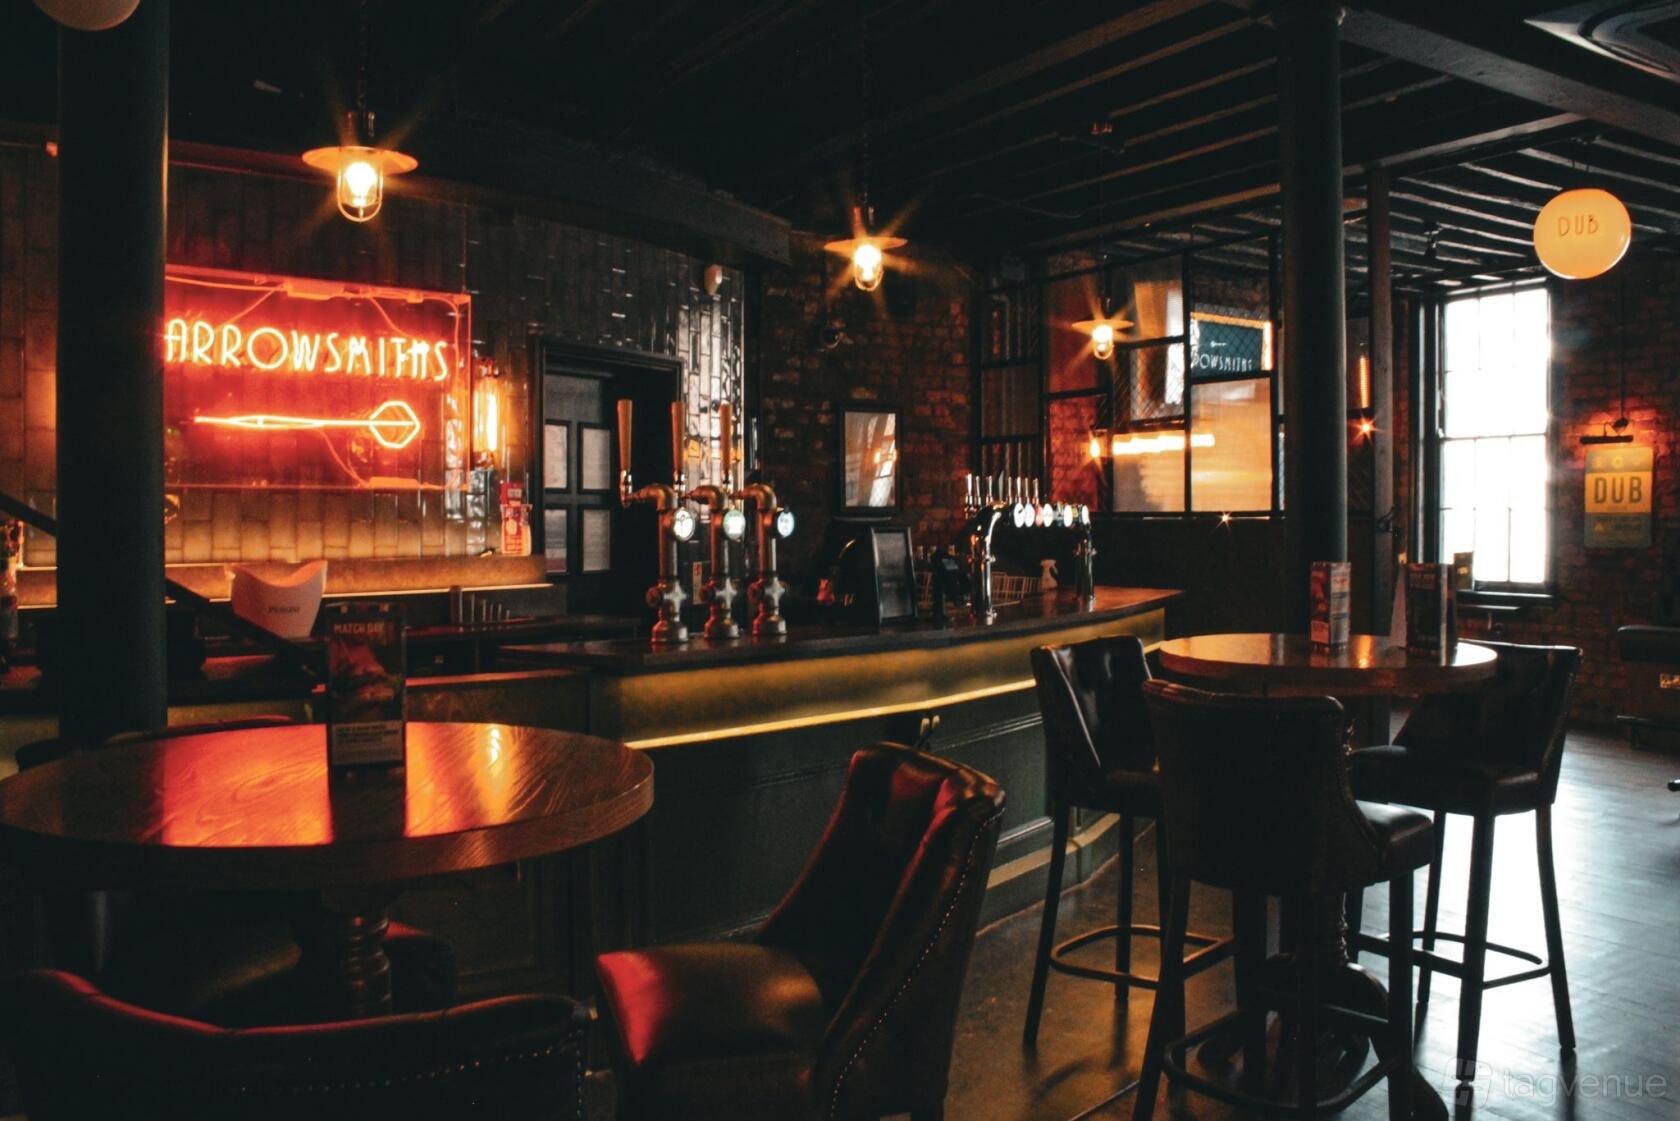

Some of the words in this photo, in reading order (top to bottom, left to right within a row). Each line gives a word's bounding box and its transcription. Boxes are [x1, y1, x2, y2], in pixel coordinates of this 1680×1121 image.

[1557, 214, 1599, 237] DUB
[164, 318, 449, 381] ARROWSMITHS
[1594, 476, 1642, 504] DUB
